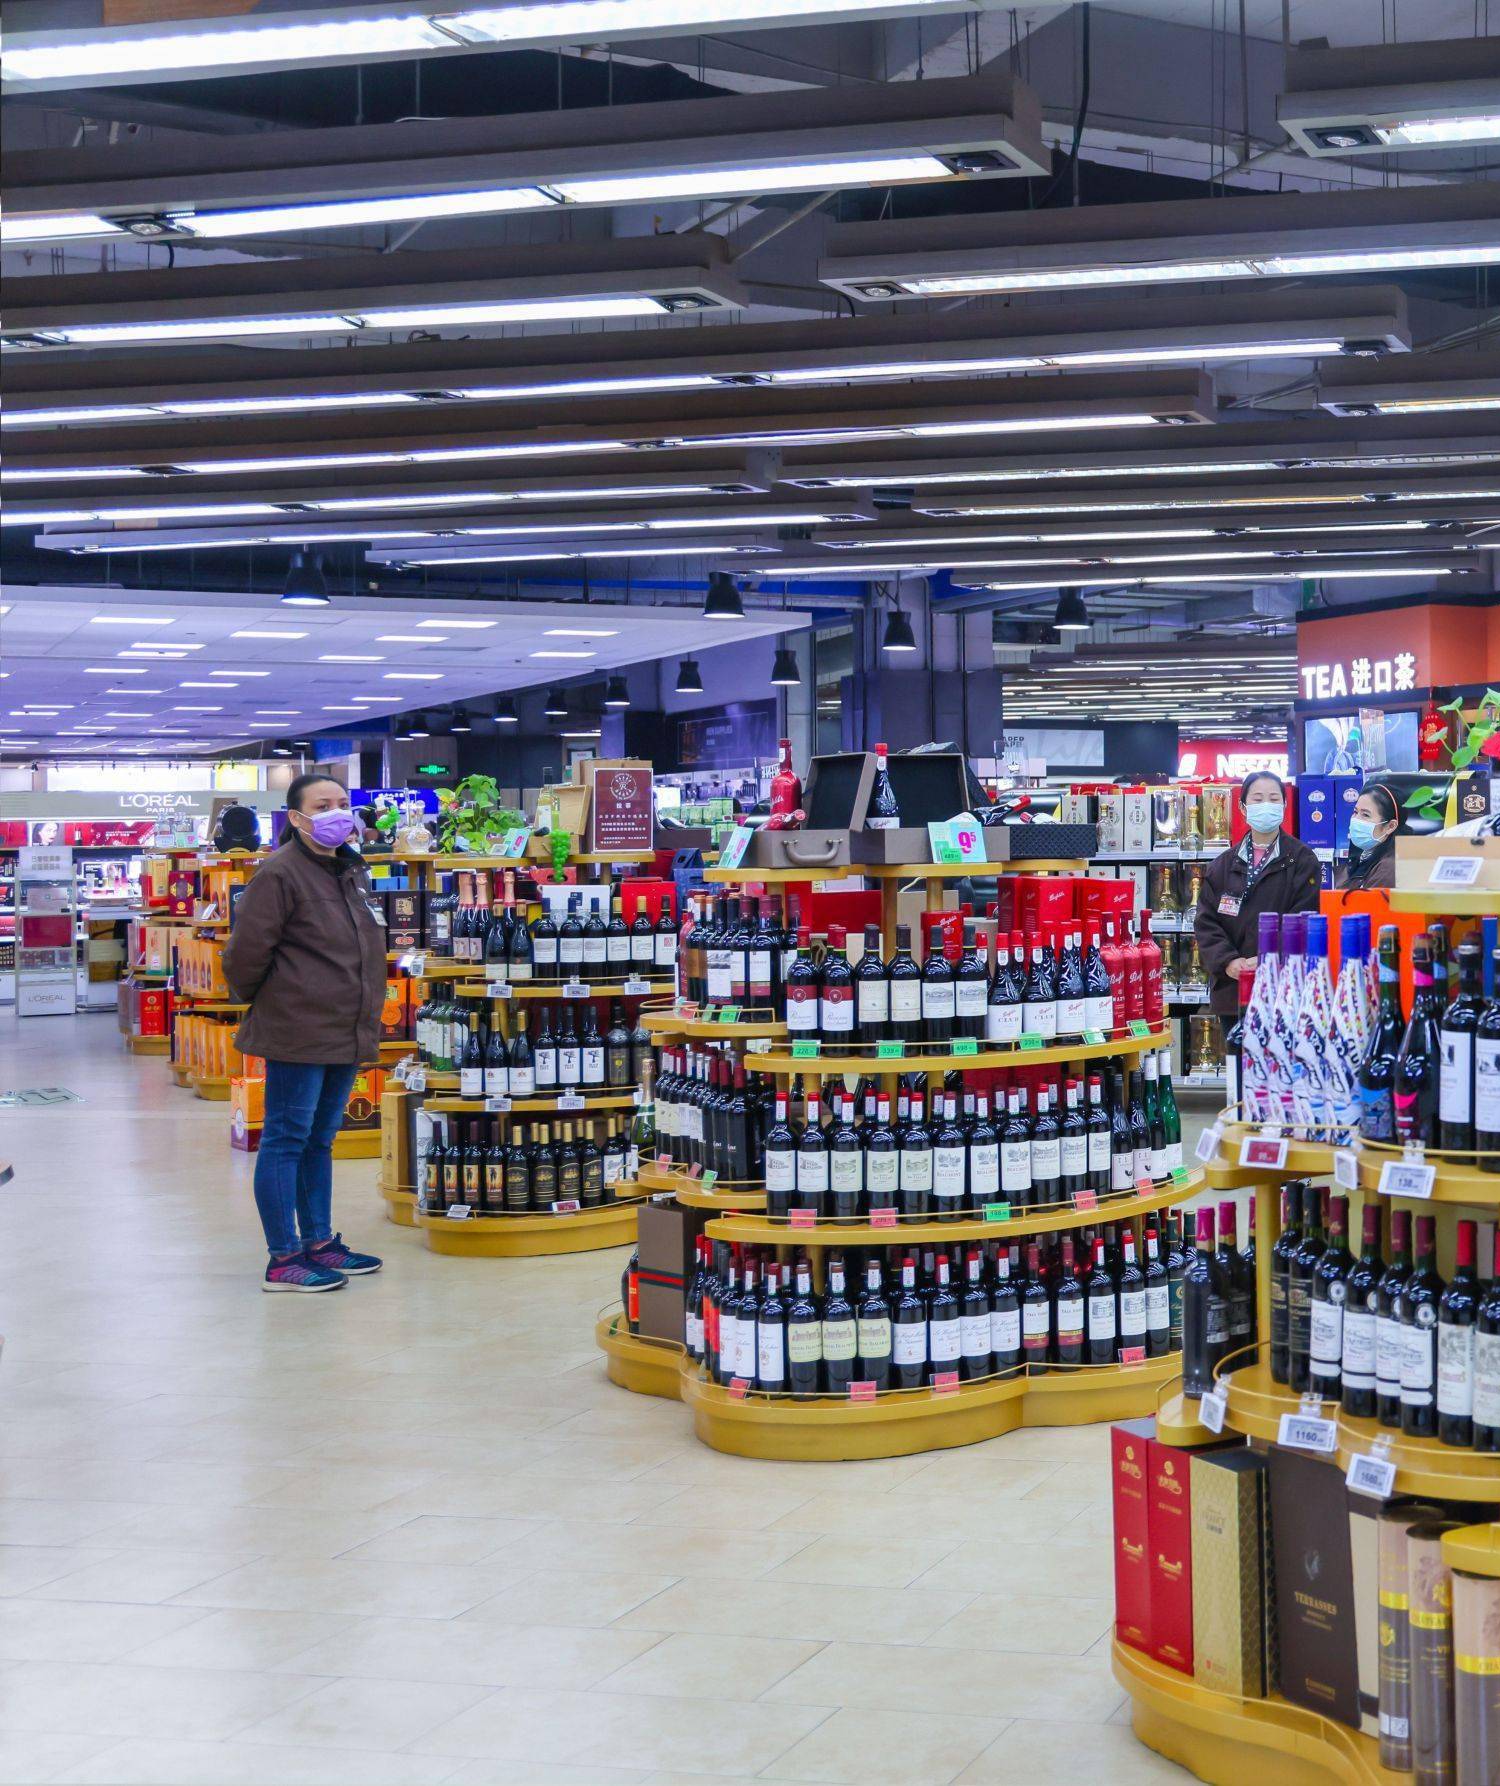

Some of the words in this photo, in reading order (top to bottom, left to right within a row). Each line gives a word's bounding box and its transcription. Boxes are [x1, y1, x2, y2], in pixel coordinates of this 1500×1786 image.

[1302, 664, 1347, 699] TEA
[1351, 652, 1415, 695] 进口茶
